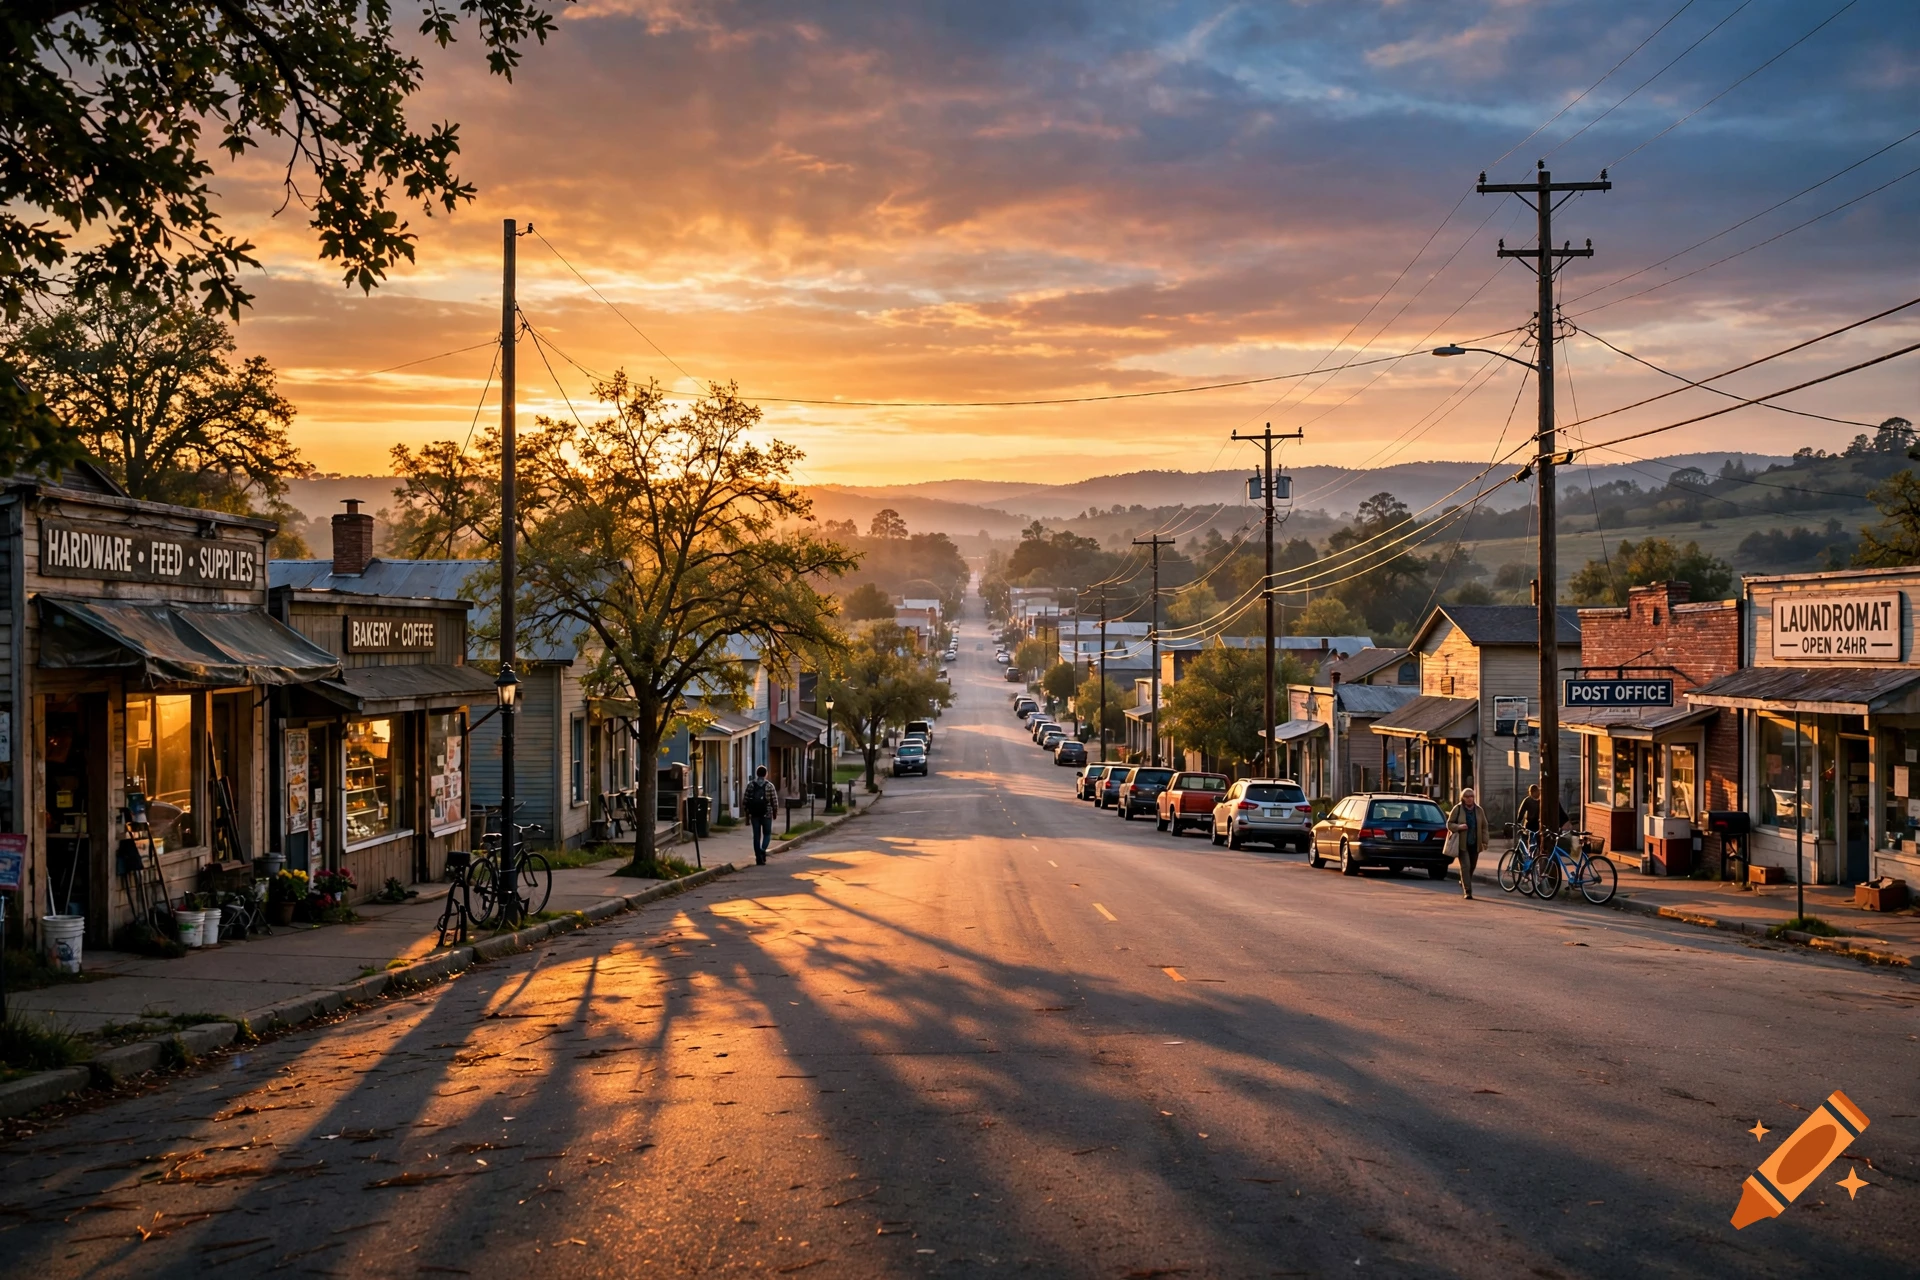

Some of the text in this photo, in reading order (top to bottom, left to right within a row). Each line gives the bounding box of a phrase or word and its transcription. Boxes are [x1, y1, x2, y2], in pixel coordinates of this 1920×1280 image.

[48, 529, 253, 583] HARDWARE FEED SUPPLIES
[1780, 601, 1891, 633] LAUNDROMAT
[352, 621, 434, 647] BAKERY COFFEE
[1801, 636, 1867, 655] OPEN 24HR
[1571, 685, 1667, 701] POST OFFICE
